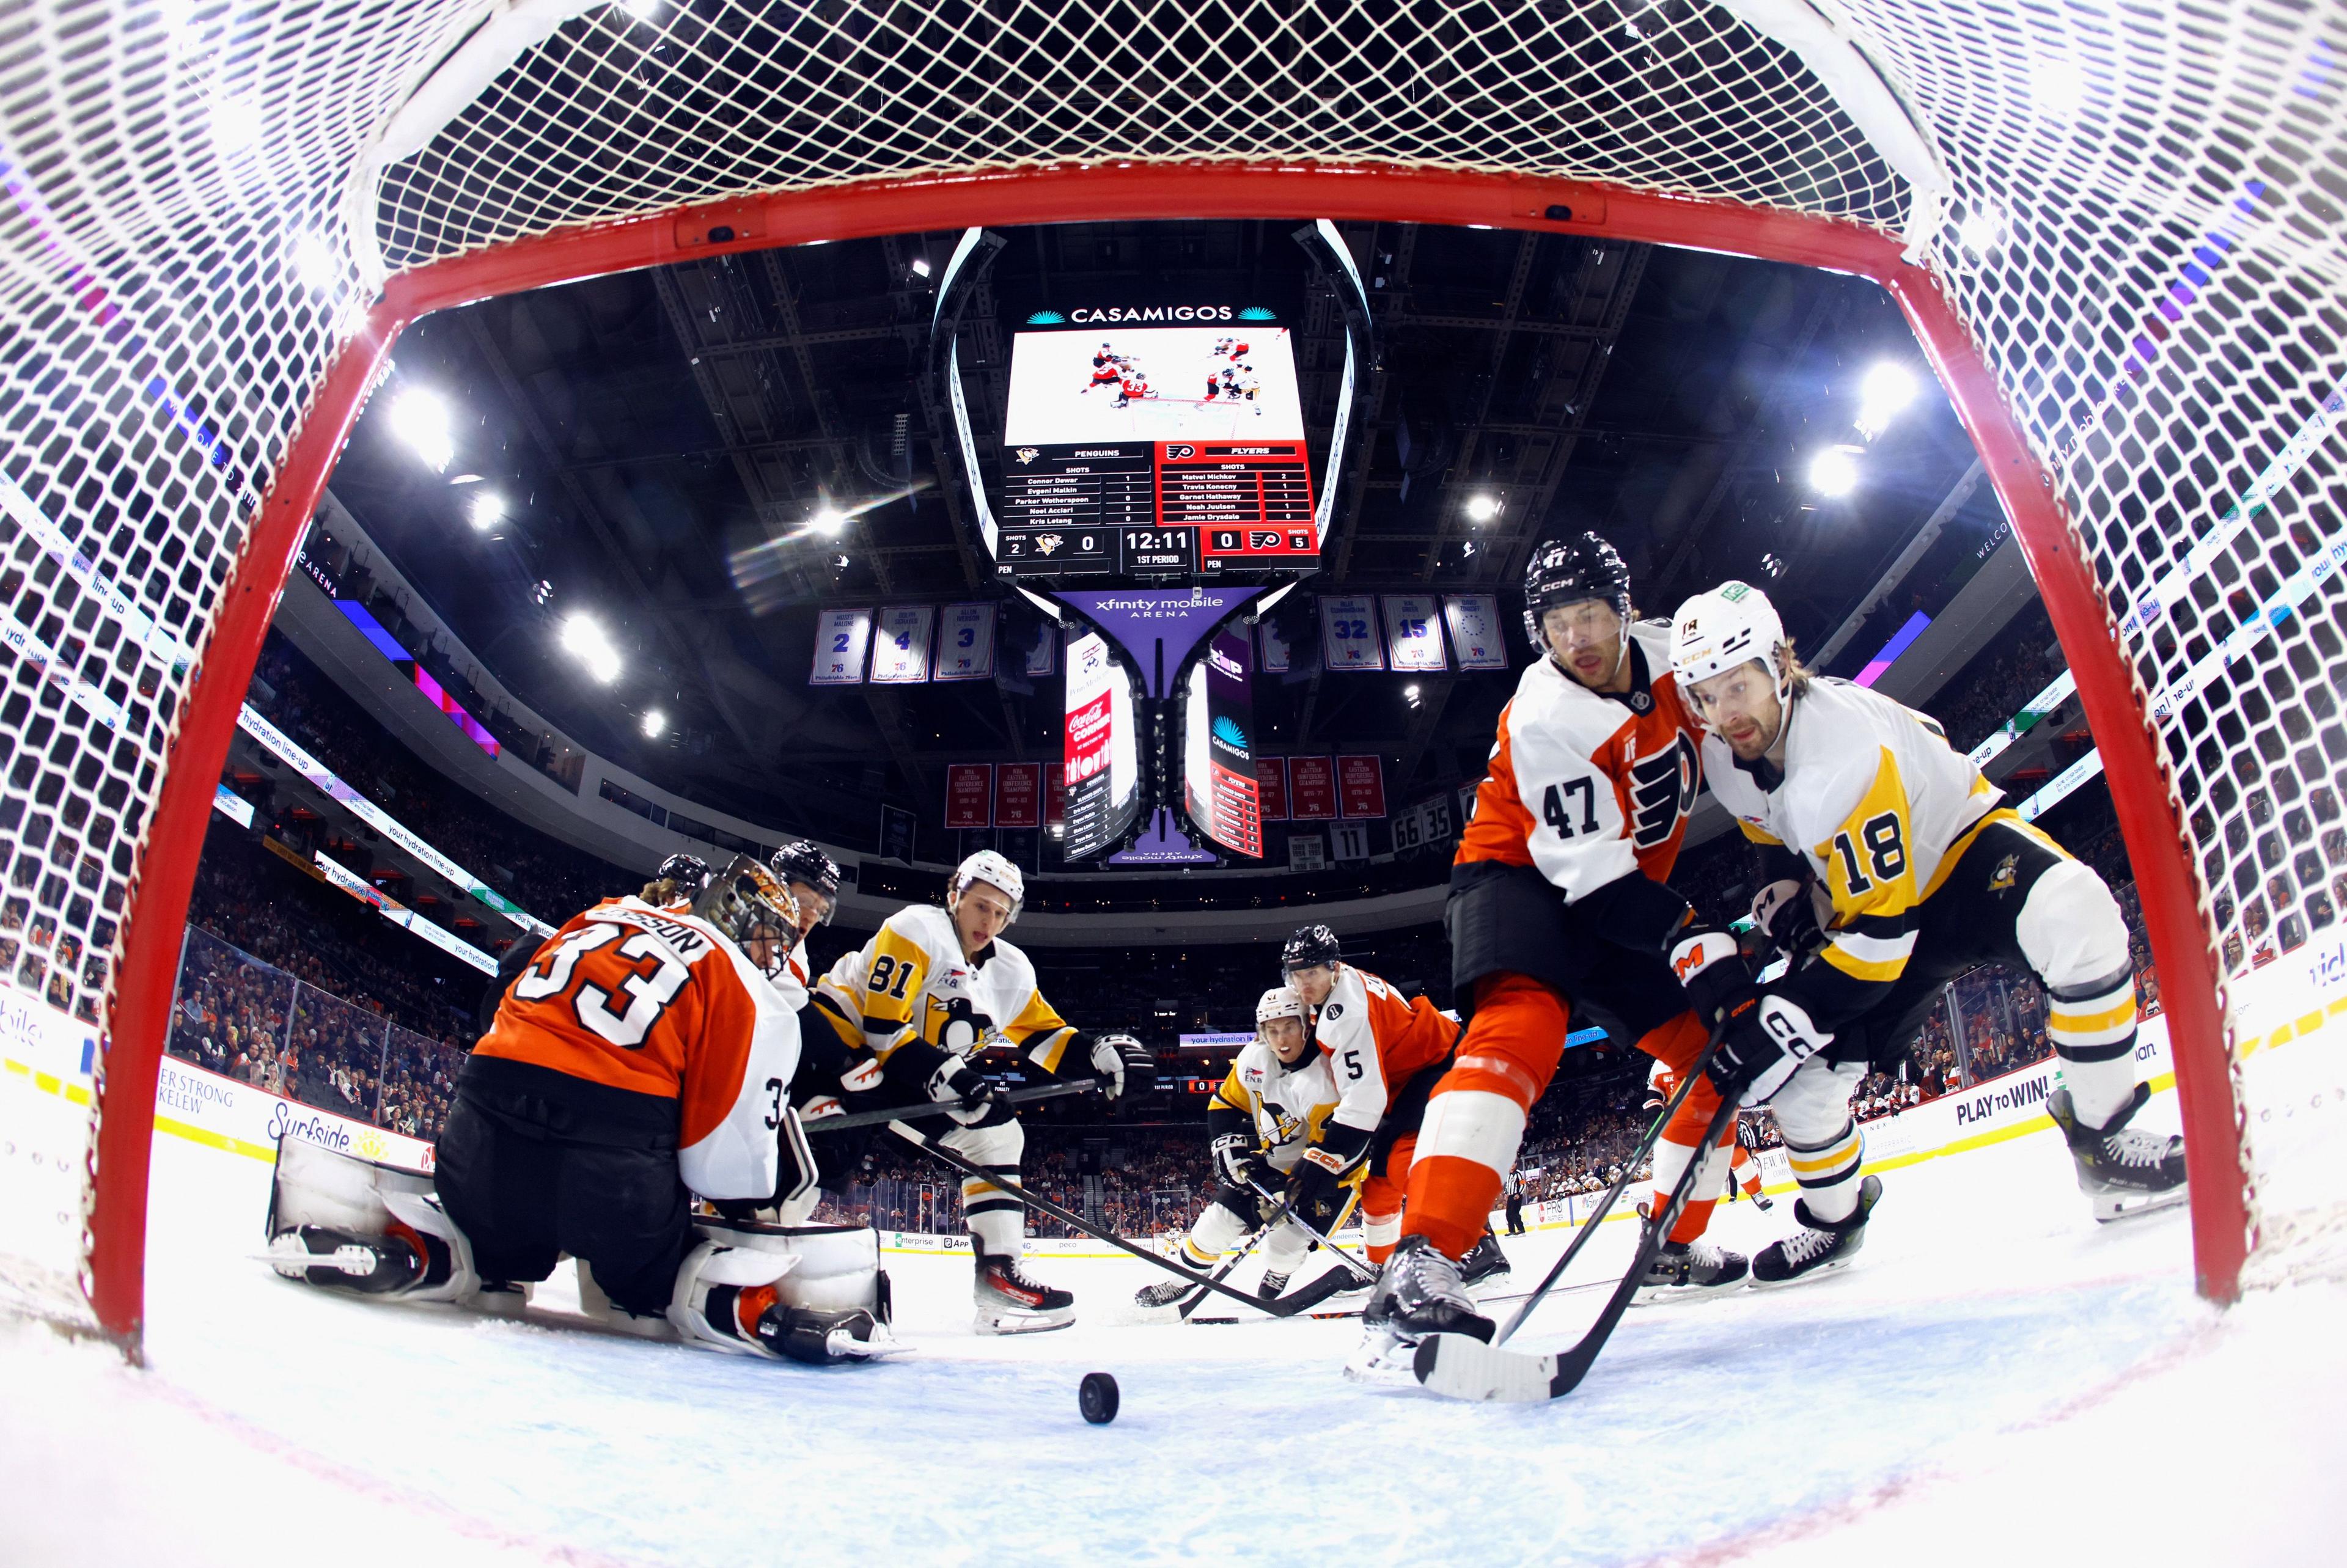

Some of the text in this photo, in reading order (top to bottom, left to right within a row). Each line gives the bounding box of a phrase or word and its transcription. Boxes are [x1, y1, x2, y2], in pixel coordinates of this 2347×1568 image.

[1071, 306, 1233, 323] CASAMIGOS
[962, 418, 978, 487] line-up
[1328, 412, 1344, 480] line-up
[1012, 544, 1019, 554] 2
[1082, 537, 1093, 550] 0
[1126, 532, 1186, 549] 12:11
[1221, 533, 1233, 548] 0
[1296, 538, 1304, 548] 5
[1976, 522, 2007, 559] WELCO
[1543, 551, 1566, 569] 47
[306, 562, 337, 598] ARENA
[1541, 577, 1574, 592] CCM
[1096, 597, 1223, 610] xfinity mobile
[958, 628, 974, 648] 3
[1334, 620, 1368, 639] 32
[1400, 619, 1427, 638] 15
[832, 633, 850, 652] 2
[895, 631, 910, 650] 4
[1347, 650, 1360, 659] 76
[1411, 650, 1424, 658] 76
[1471, 648, 1485, 656] 76
[1683, 648, 1711, 665] CCM
[831, 664, 843, 672] 76
[895, 662, 906, 671] 76
[958, 659, 971, 668] 76
[1074, 713, 1111, 742] CORNER
[243, 711, 309, 770] hydration line-up
[1212, 736, 1249, 760] CASAMIGOS
[1972, 746, 1992, 764] e-up
[1228, 777, 1246, 788] FLYERS
[1544, 775, 1600, 840] 47
[1427, 806, 1448, 838] 35
[1395, 816, 1419, 848] 66
[389, 825, 454, 876] your hydration line-up
[1340, 830, 1360, 857] 11
[1835, 810, 1905, 897] 18
[515, 912, 554, 939] your hyation
[455, 943, 495, 972] your hydration
[513, 921, 691, 1050] 33
[868, 954, 916, 1000] 81
[1731, 998, 1756, 1017] CCM
[1210, 1035, 1246, 1044] hydration
[1766, 1011, 1815, 1060] CC
[1344, 1049, 1363, 1080] 5
[180, 1074, 234, 1108] STRONG
[1199, 1082, 1205, 1090] 0
[159, 1086, 203, 1115] KELEW
[1957, 1075, 2050, 1126] PLAY TO WIN!
[267, 1101, 350, 1152] Surfside
[1307, 1149, 1343, 1171] CCM
[1546, 1201, 1563, 1214] PRO
[1630, 1194, 1656, 1205] Constellati
[895, 1234, 934, 1246] enterprise
